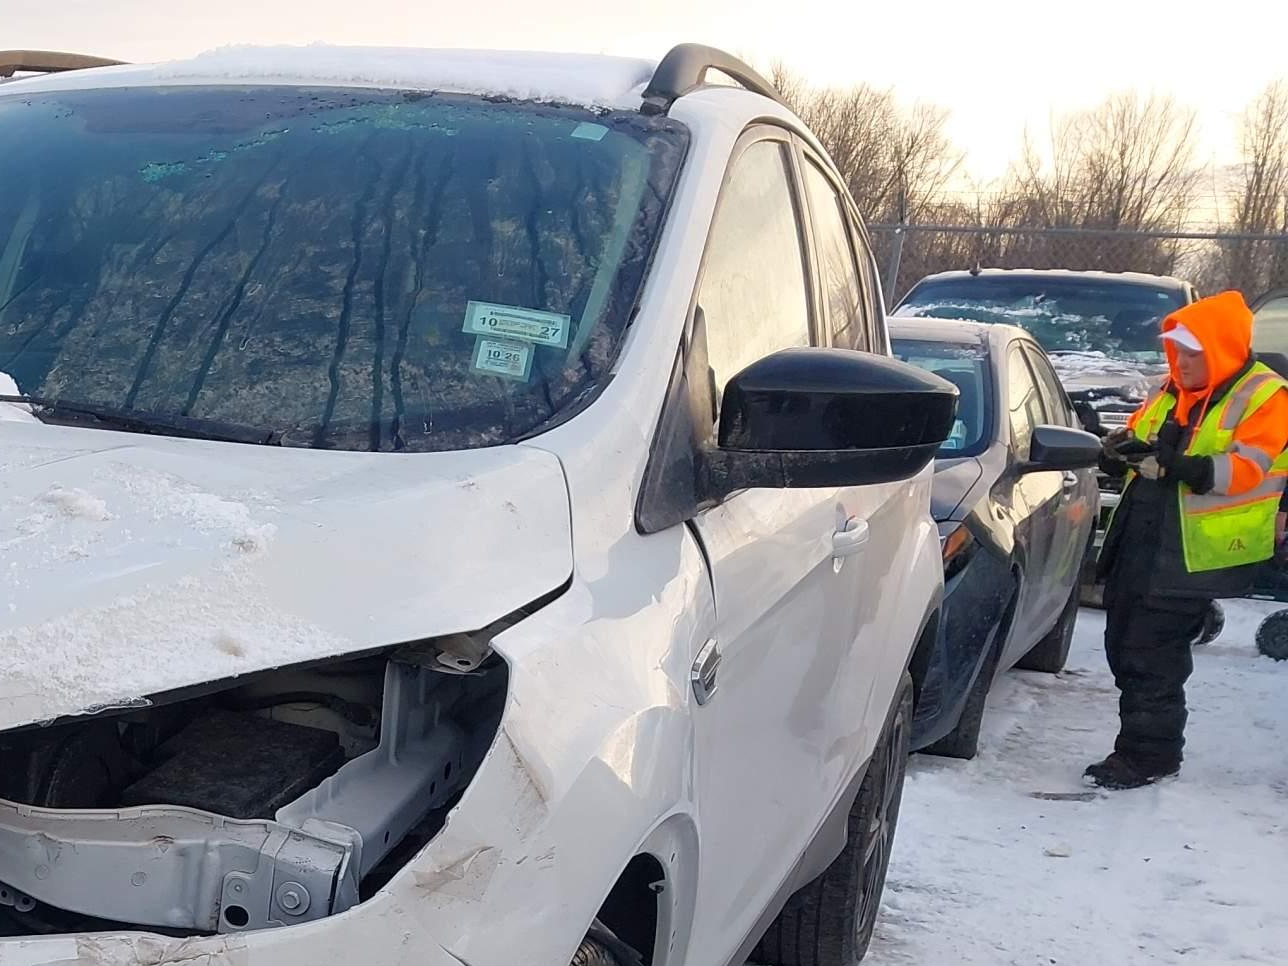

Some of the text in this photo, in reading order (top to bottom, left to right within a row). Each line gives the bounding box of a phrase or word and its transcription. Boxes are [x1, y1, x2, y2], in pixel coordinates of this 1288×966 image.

[479, 316, 498, 327] 10
[540, 326, 561, 337] 27
[488, 349, 520, 362] 10 26
